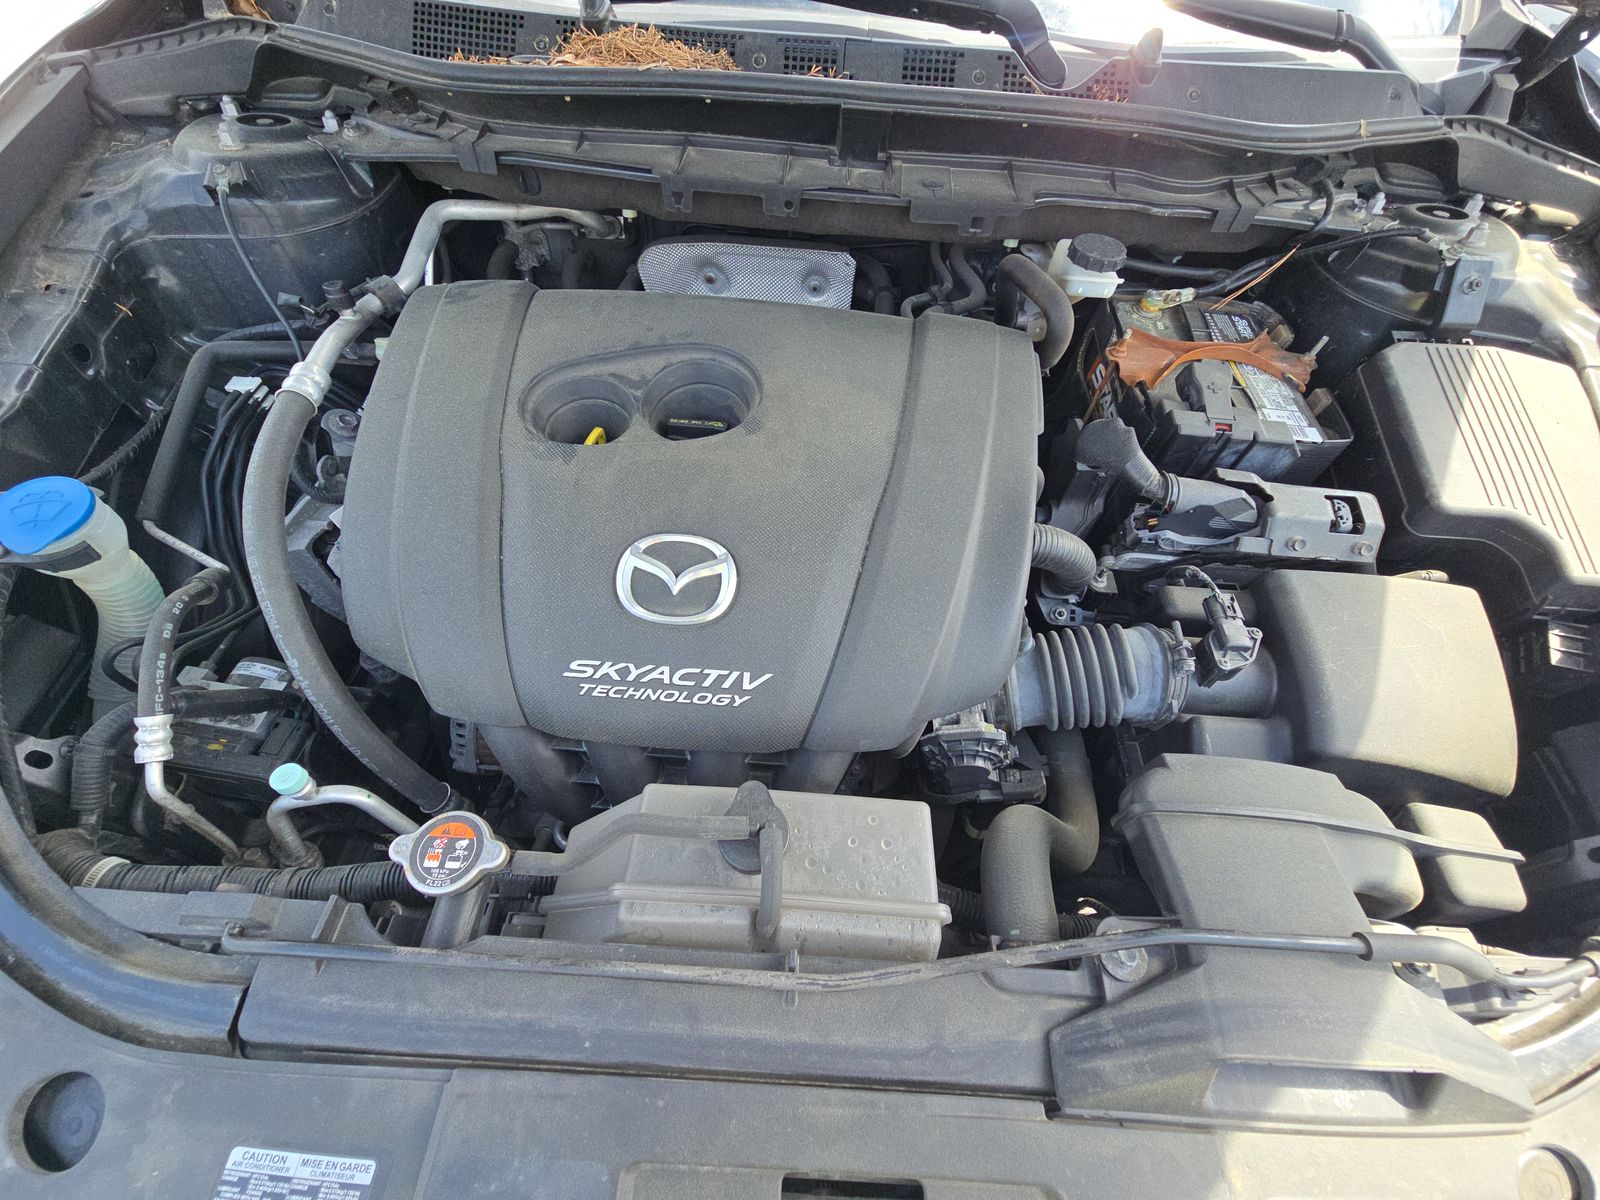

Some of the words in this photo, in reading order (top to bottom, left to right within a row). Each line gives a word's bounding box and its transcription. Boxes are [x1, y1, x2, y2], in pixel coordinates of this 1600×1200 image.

[562, 659, 774, 691] SKYACTIV
[578, 683, 753, 707] TECHNOLOGY
[242, 1150, 289, 1165] CAUTION
[231, 1160, 243, 1168] AIR
[243, 1161, 291, 1174] CONDITIONER
[300, 1158, 323, 1169] MISE
[325, 1161, 339, 1170] EN
[339, 1161, 373, 1174] GARDE
[309, 1169, 356, 1181] CLIMATISEUR
